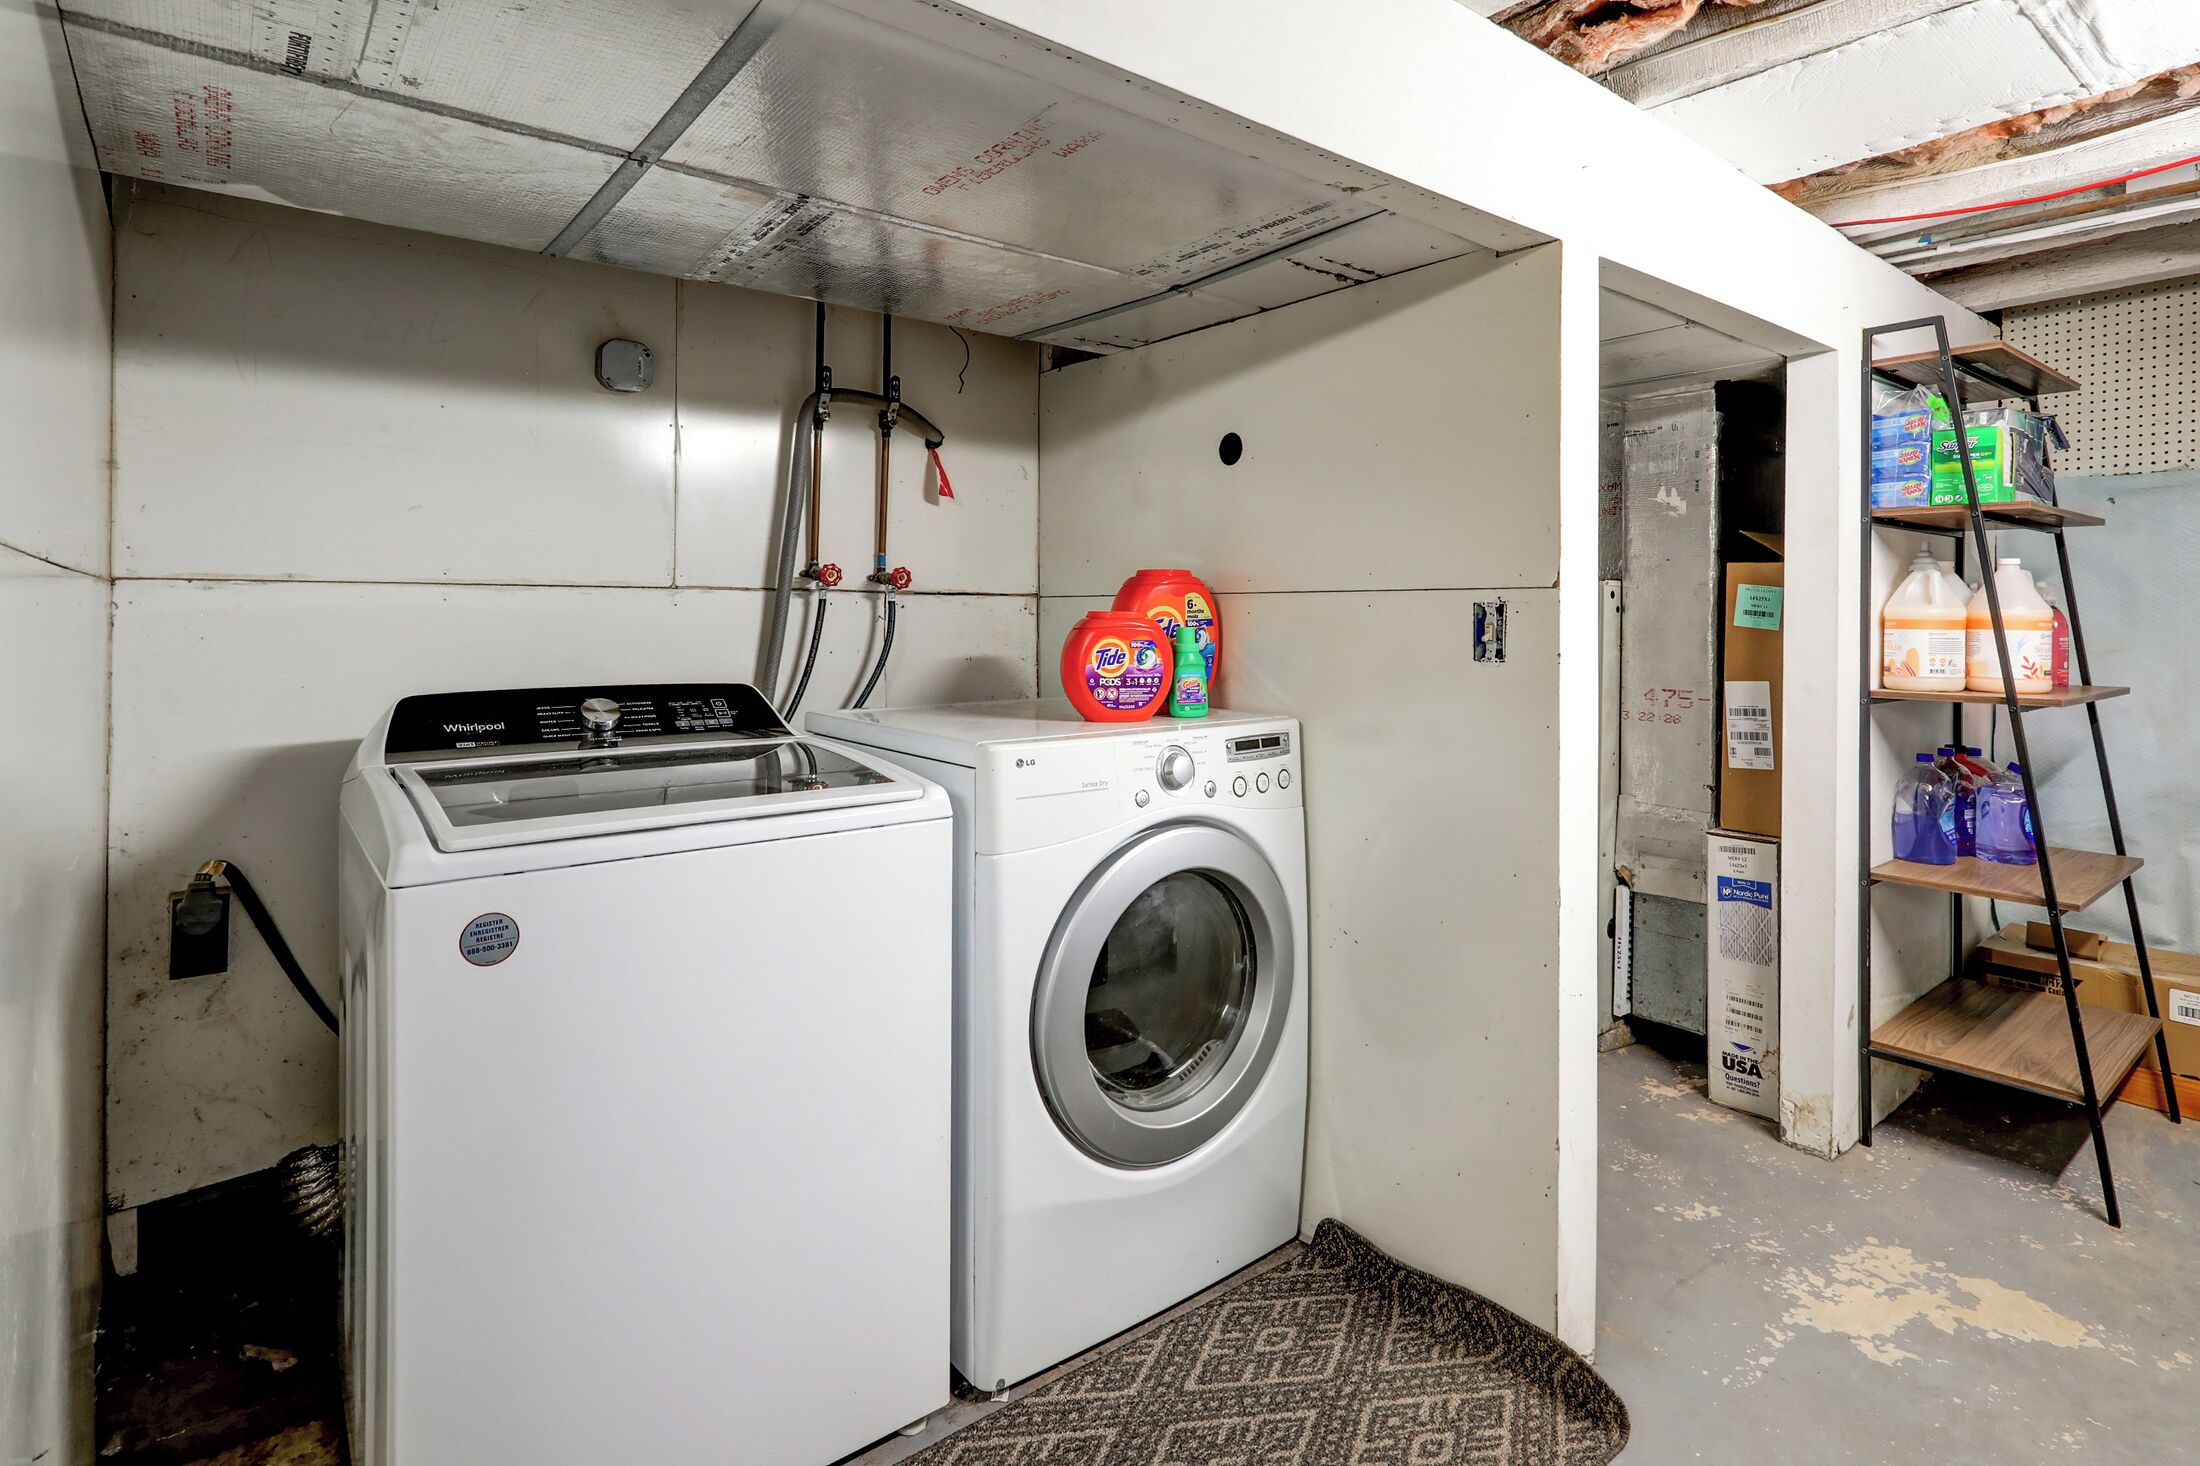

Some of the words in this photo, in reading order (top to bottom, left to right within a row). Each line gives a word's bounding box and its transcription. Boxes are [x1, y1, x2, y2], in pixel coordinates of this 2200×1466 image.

[1095, 647, 1127, 671] Tide
[1099, 677, 1122, 686] PODS
[443, 721, 505, 733] Whirlpool
[1025, 759, 1036, 767] LG
[1081, 781, 1099, 789] Sensor
[1733, 889, 1754, 898] Nordic
[1753, 892, 1769, 900] Pure
[475, 919, 504, 929] REGISTER
[470, 925, 510, 938] ENREGISTRER
[475, 933, 504, 943] REGISTRE
[1722, 1051, 1739, 1060] MADE
[1722, 1055, 1764, 1080] USA
[1725, 1072, 1760, 1088] Questions?
